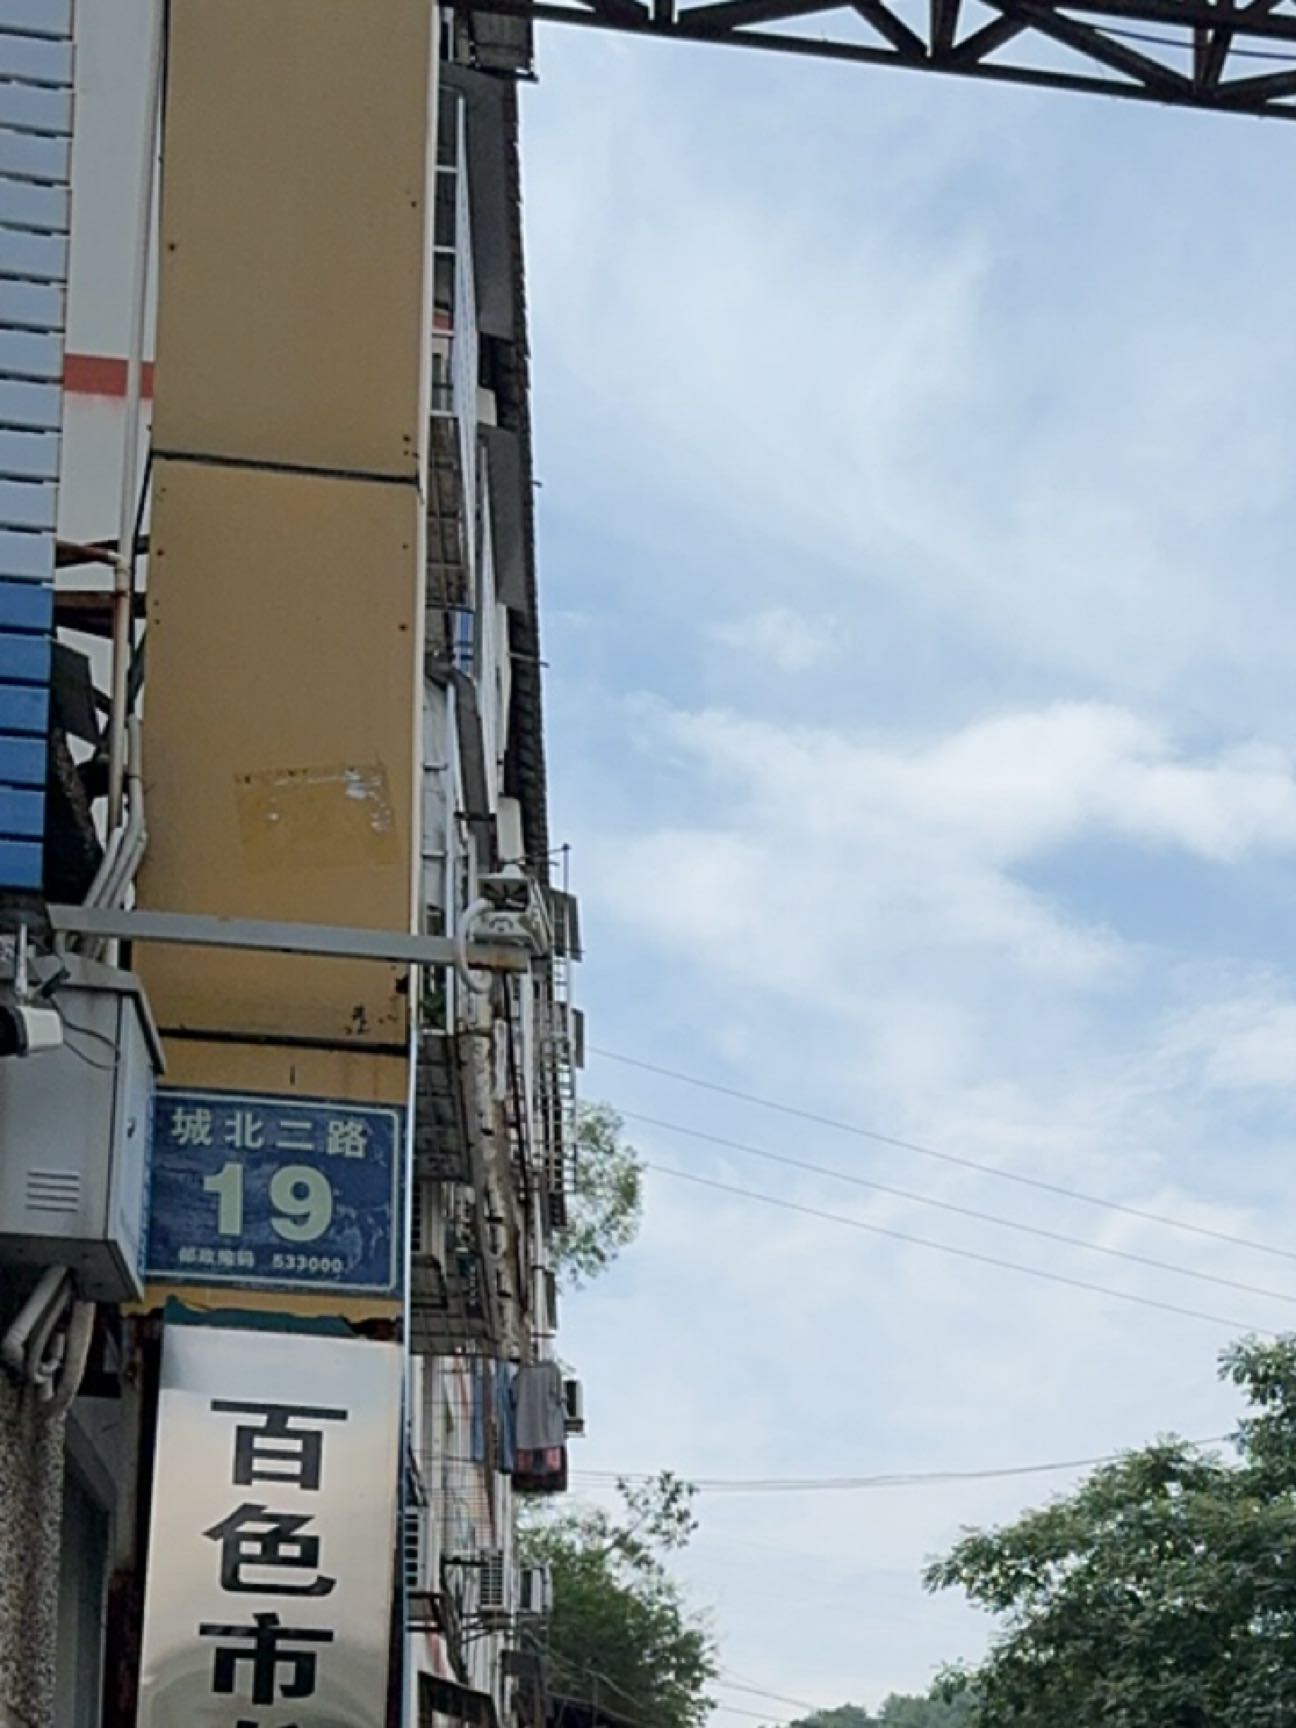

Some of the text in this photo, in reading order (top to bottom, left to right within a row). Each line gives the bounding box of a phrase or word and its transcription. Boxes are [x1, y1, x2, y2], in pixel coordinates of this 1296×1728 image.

[171, 1107, 367, 1159] 城北二路
[203, 1161, 333, 1241] 19
